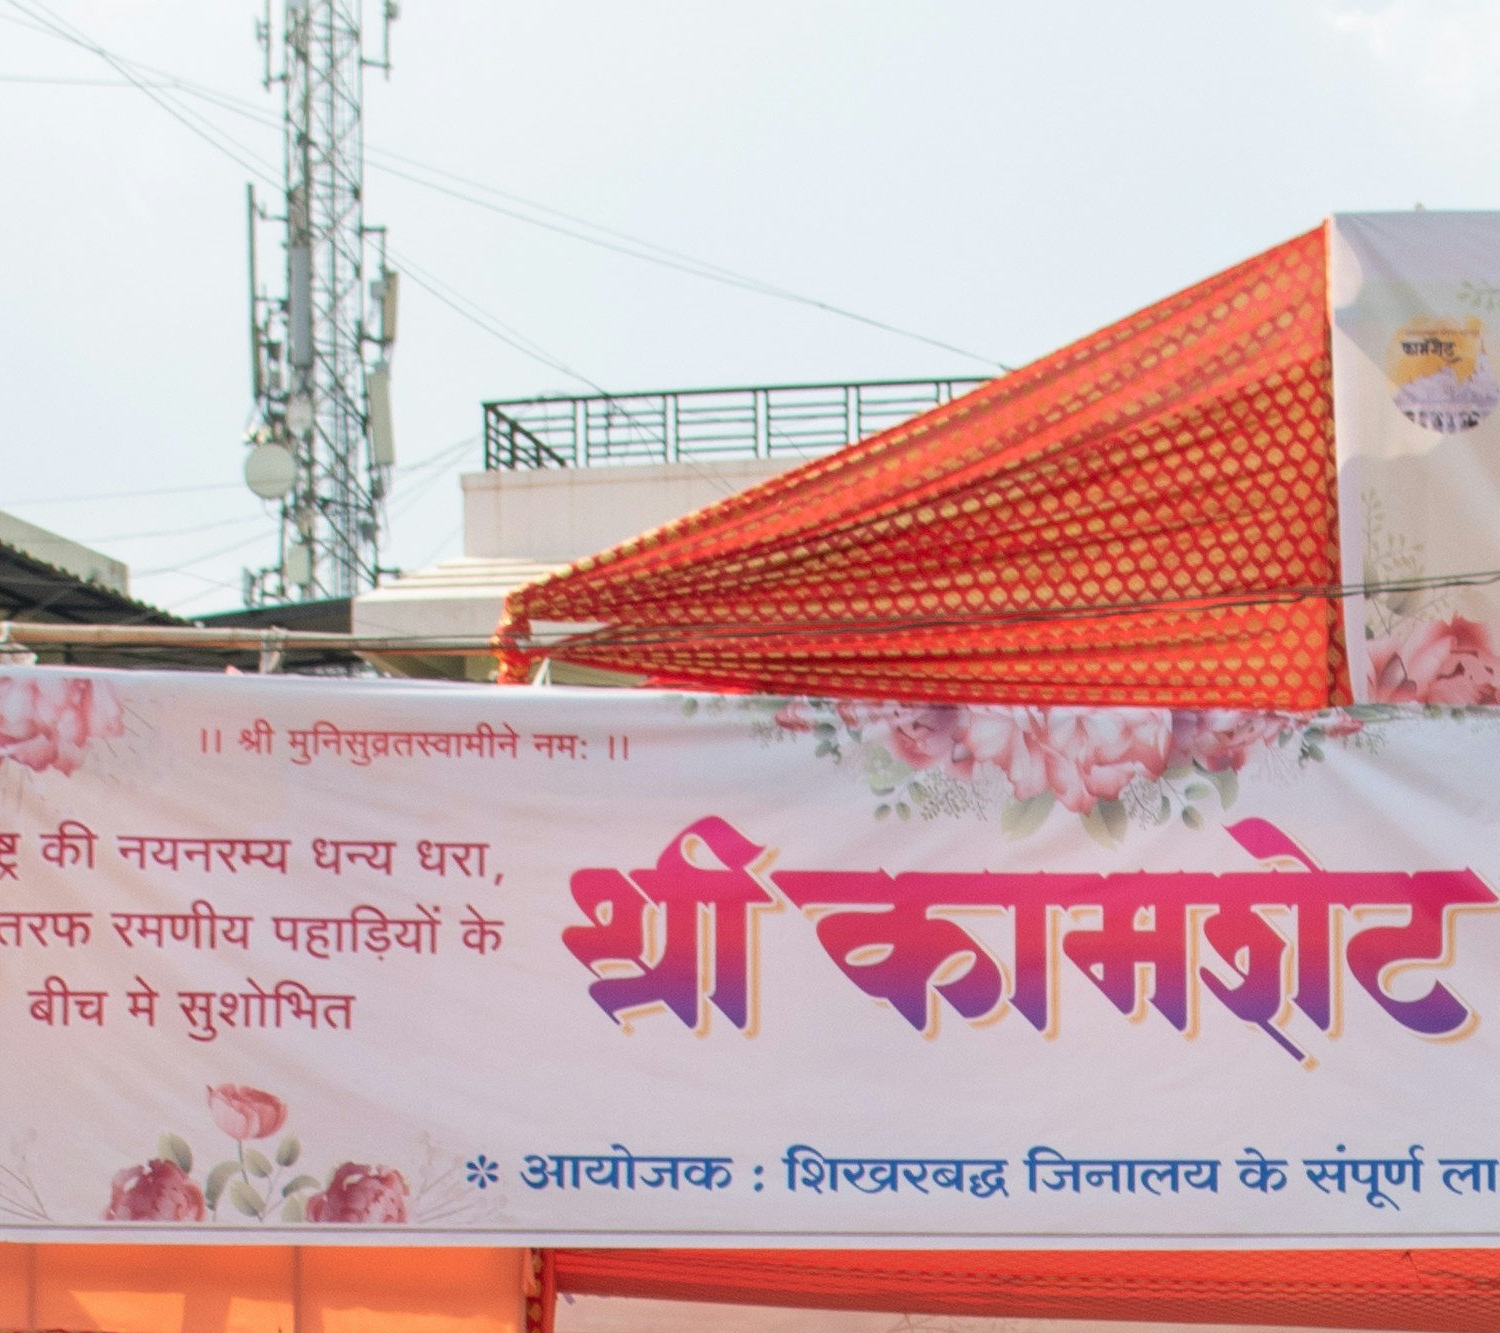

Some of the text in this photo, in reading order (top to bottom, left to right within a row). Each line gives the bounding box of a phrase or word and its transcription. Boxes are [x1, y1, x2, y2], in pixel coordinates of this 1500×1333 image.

[237, 719, 274, 756] श्री
[40, 820, 98, 873] की
[117, 833, 291, 876] नयनरम्य
[312, 838, 396, 877] धन्य
[416, 838, 506, 887] धरा,
[111, 899, 253, 951] रमणीय
[273, 904, 442, 963] पहाड़ियों
[461, 904, 505, 957] के
[561, 815, 781, 1038] श्री
[27, 975, 357, 1044] बीच मे सुशोभित
[519, 1143, 733, 1193] आयोजक
[782, 1145, 1010, 1199] शिखरबद्ध
[1023, 1146, 1222, 1194] जिनालय
[1236, 1146, 1289, 1194] के
[1304, 1143, 1424, 1210] संपूर्ण
